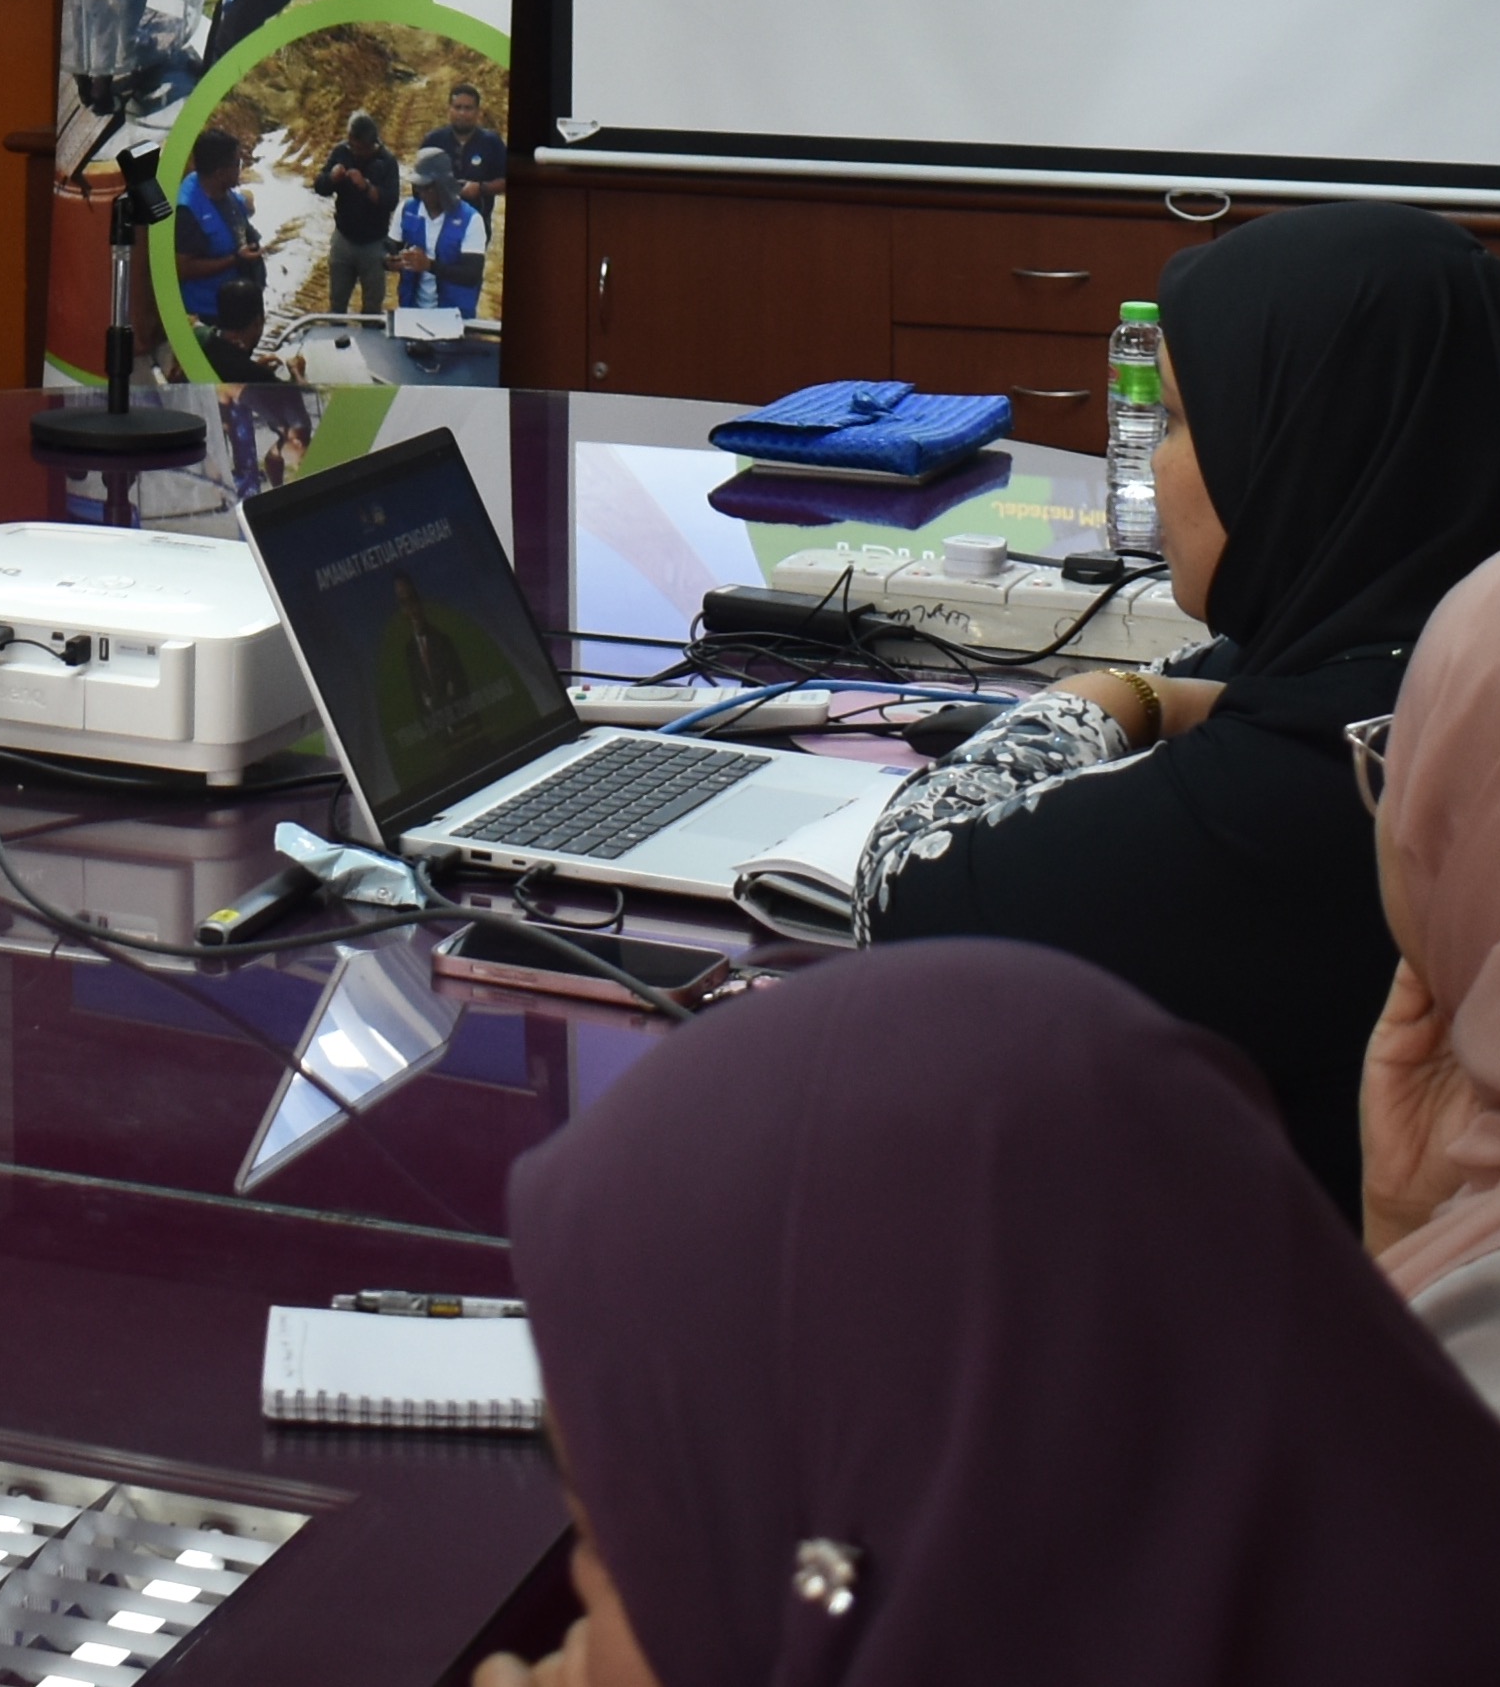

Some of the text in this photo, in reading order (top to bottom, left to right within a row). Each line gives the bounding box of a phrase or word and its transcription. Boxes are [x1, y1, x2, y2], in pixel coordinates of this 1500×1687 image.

[315, 518, 452, 592] AMANAT KETUA PENGARAH
